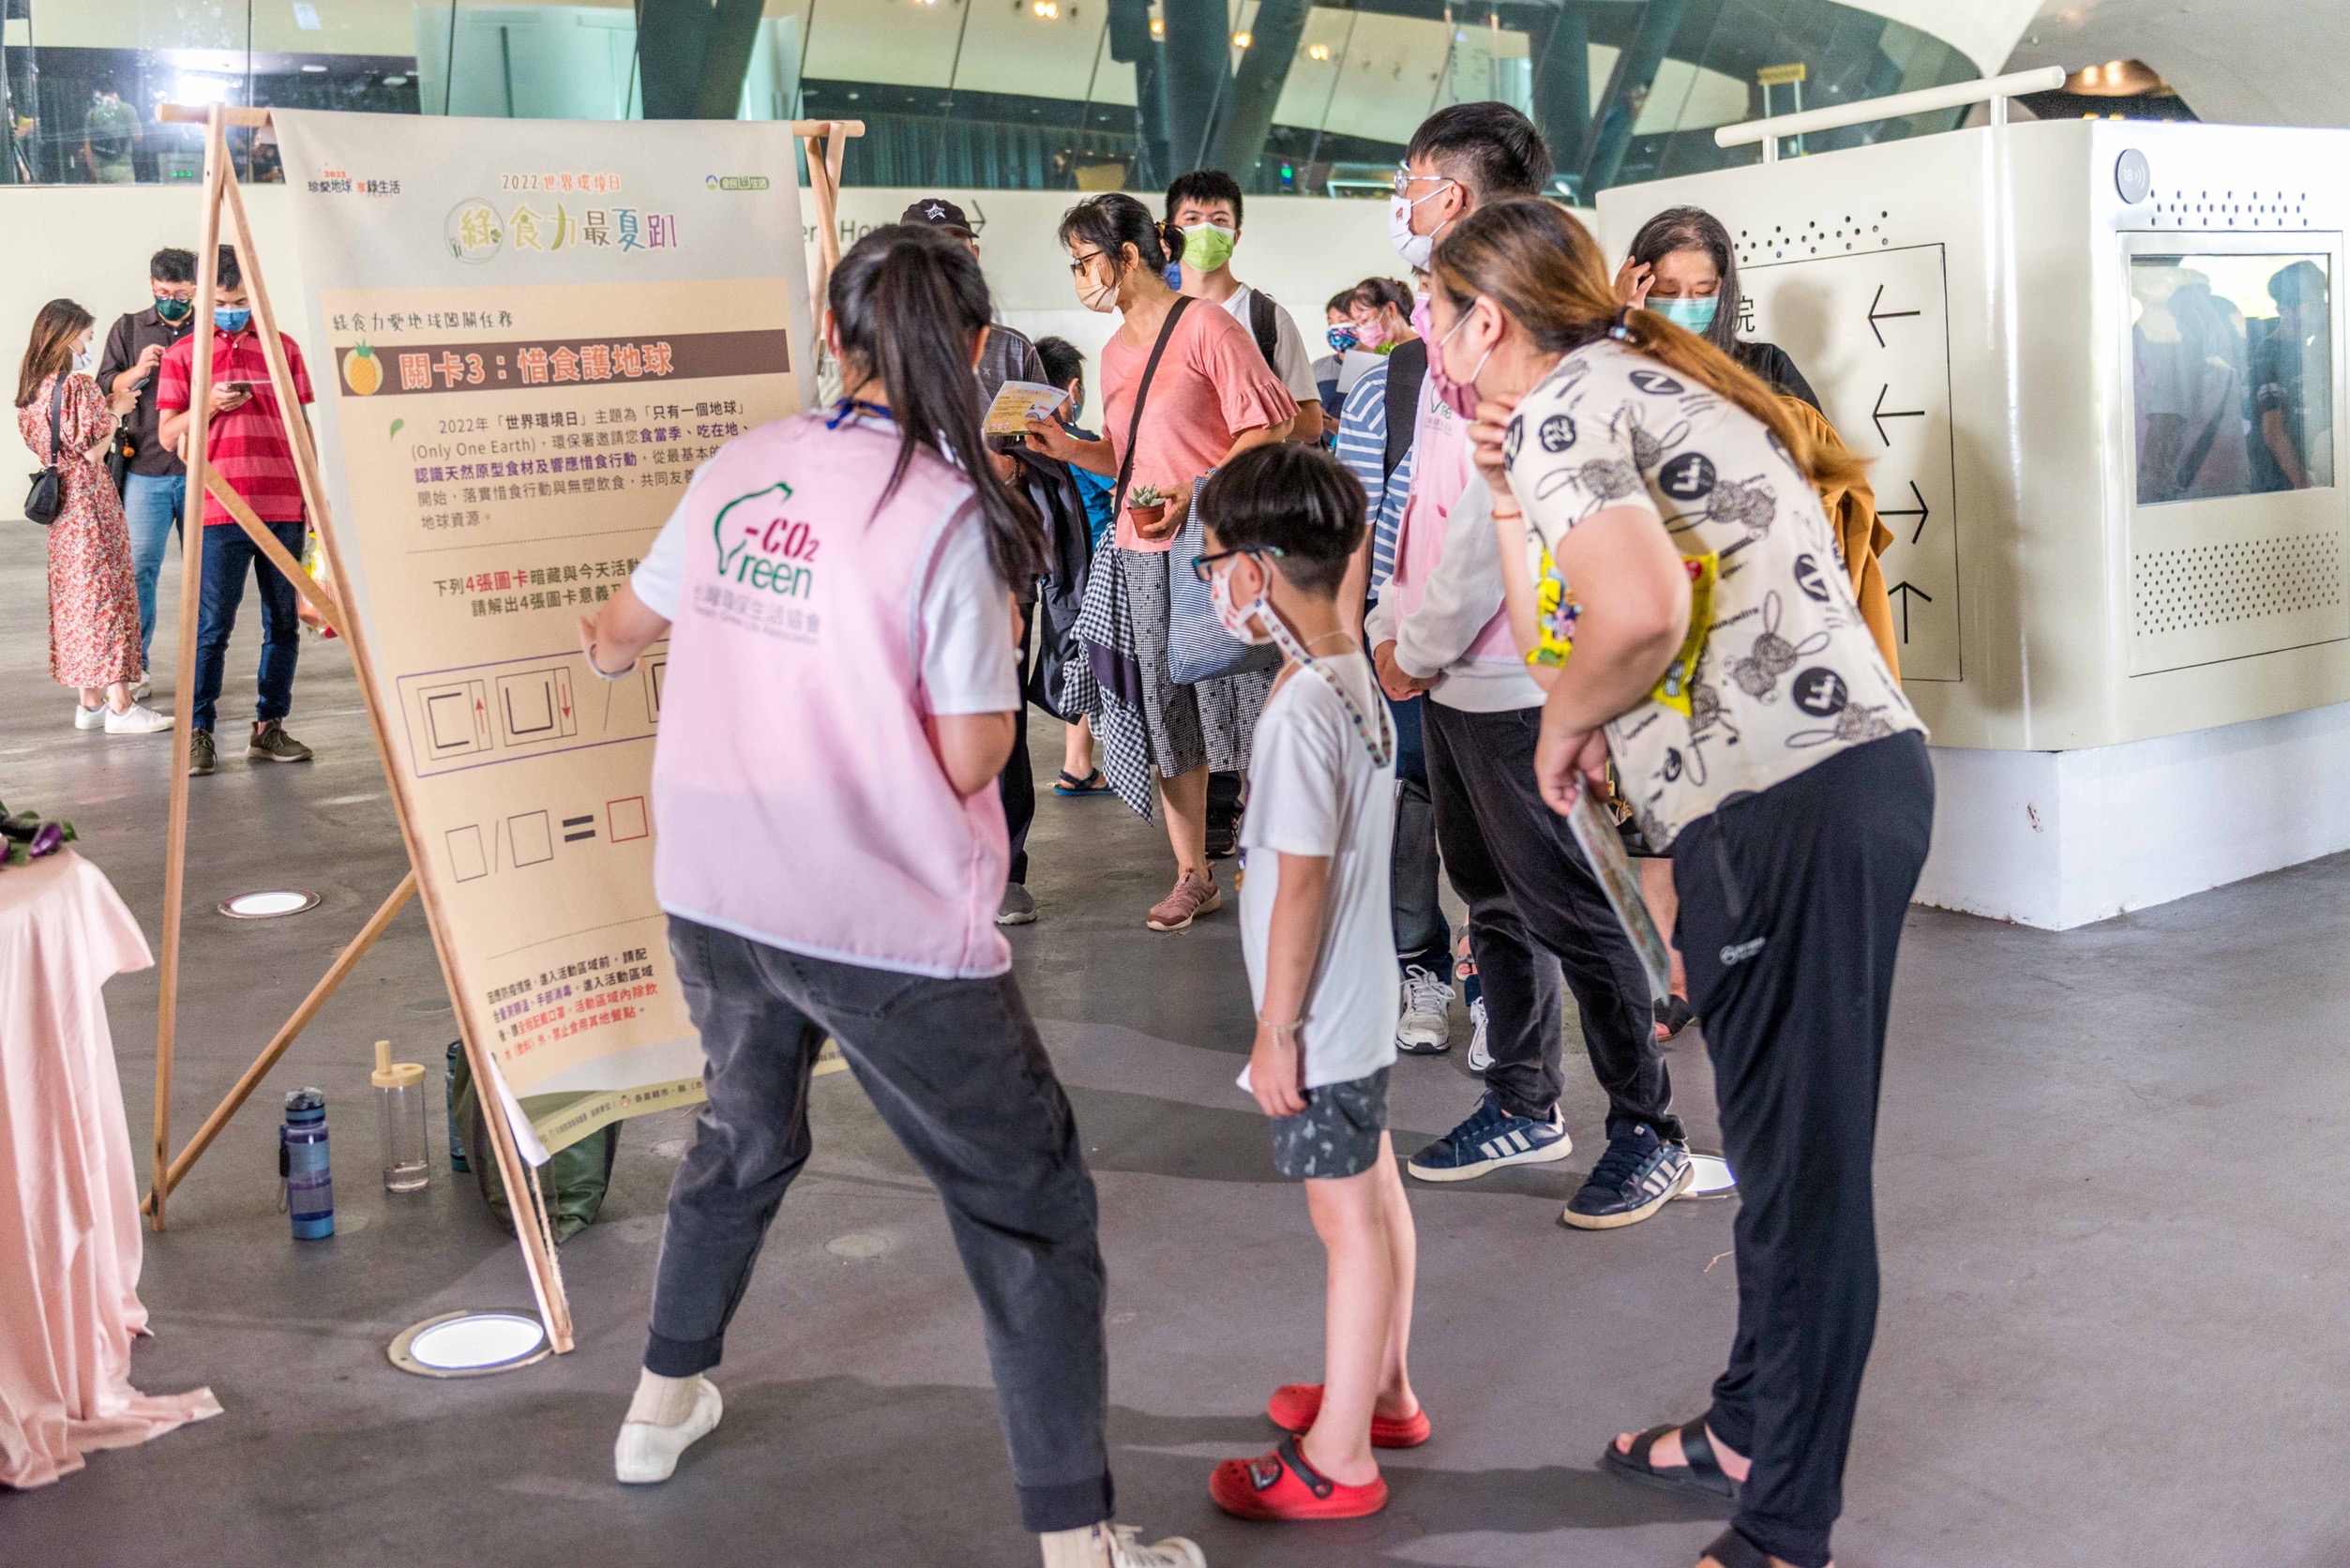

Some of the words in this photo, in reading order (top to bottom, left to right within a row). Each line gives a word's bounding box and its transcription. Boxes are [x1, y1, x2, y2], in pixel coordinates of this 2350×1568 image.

[399, 340, 675, 390] 關卡3：惜食護地球
[456, 441, 486, 456] One
[420, 510, 491, 531] 地球資源。
